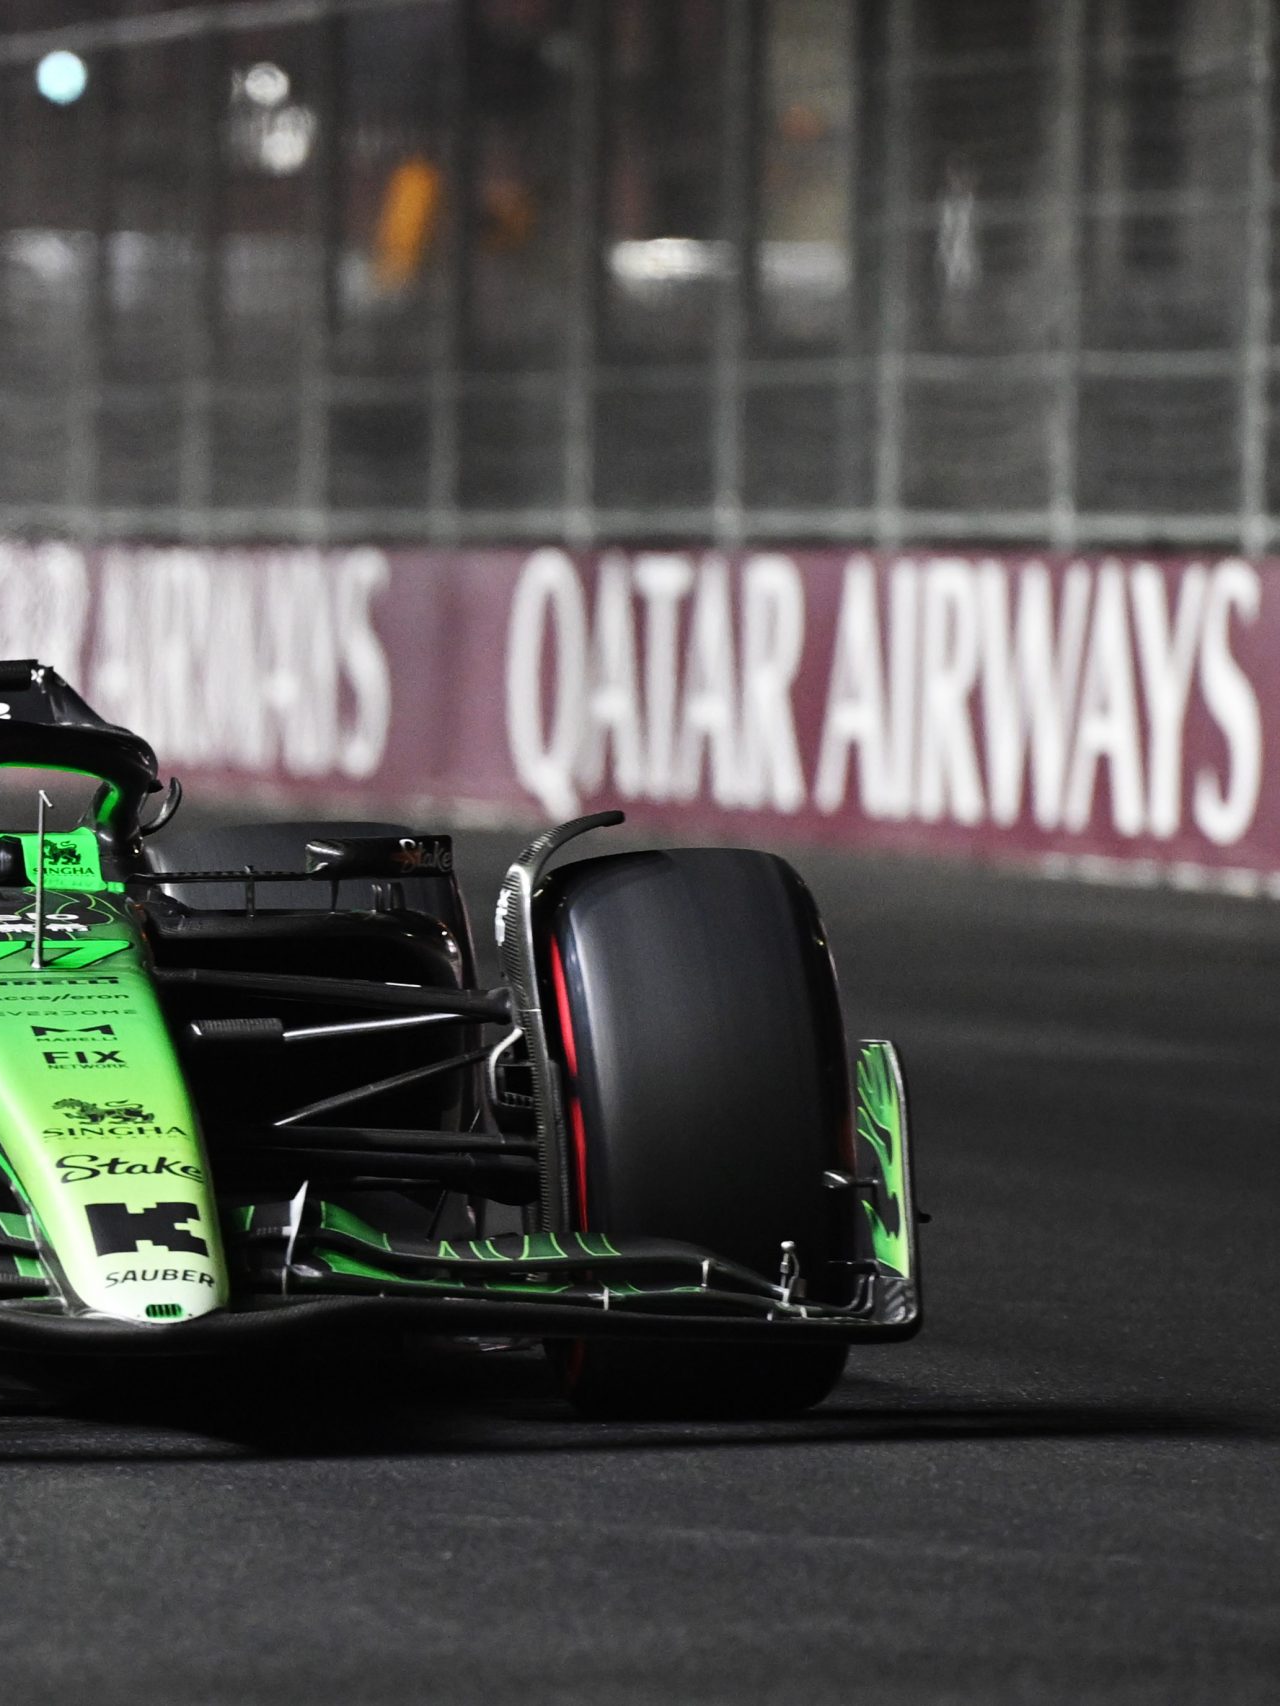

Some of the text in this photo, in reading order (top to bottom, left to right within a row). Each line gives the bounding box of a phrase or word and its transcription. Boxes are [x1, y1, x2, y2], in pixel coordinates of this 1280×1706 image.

[506, 548, 1262, 844] QATAR AIRWAYS
[43, 1051, 126, 1065] FIX
[43, 1125, 188, 1136] SINGHA
[55, 1154, 205, 1184] Stake
[105, 1269, 216, 1289] SAUBER
